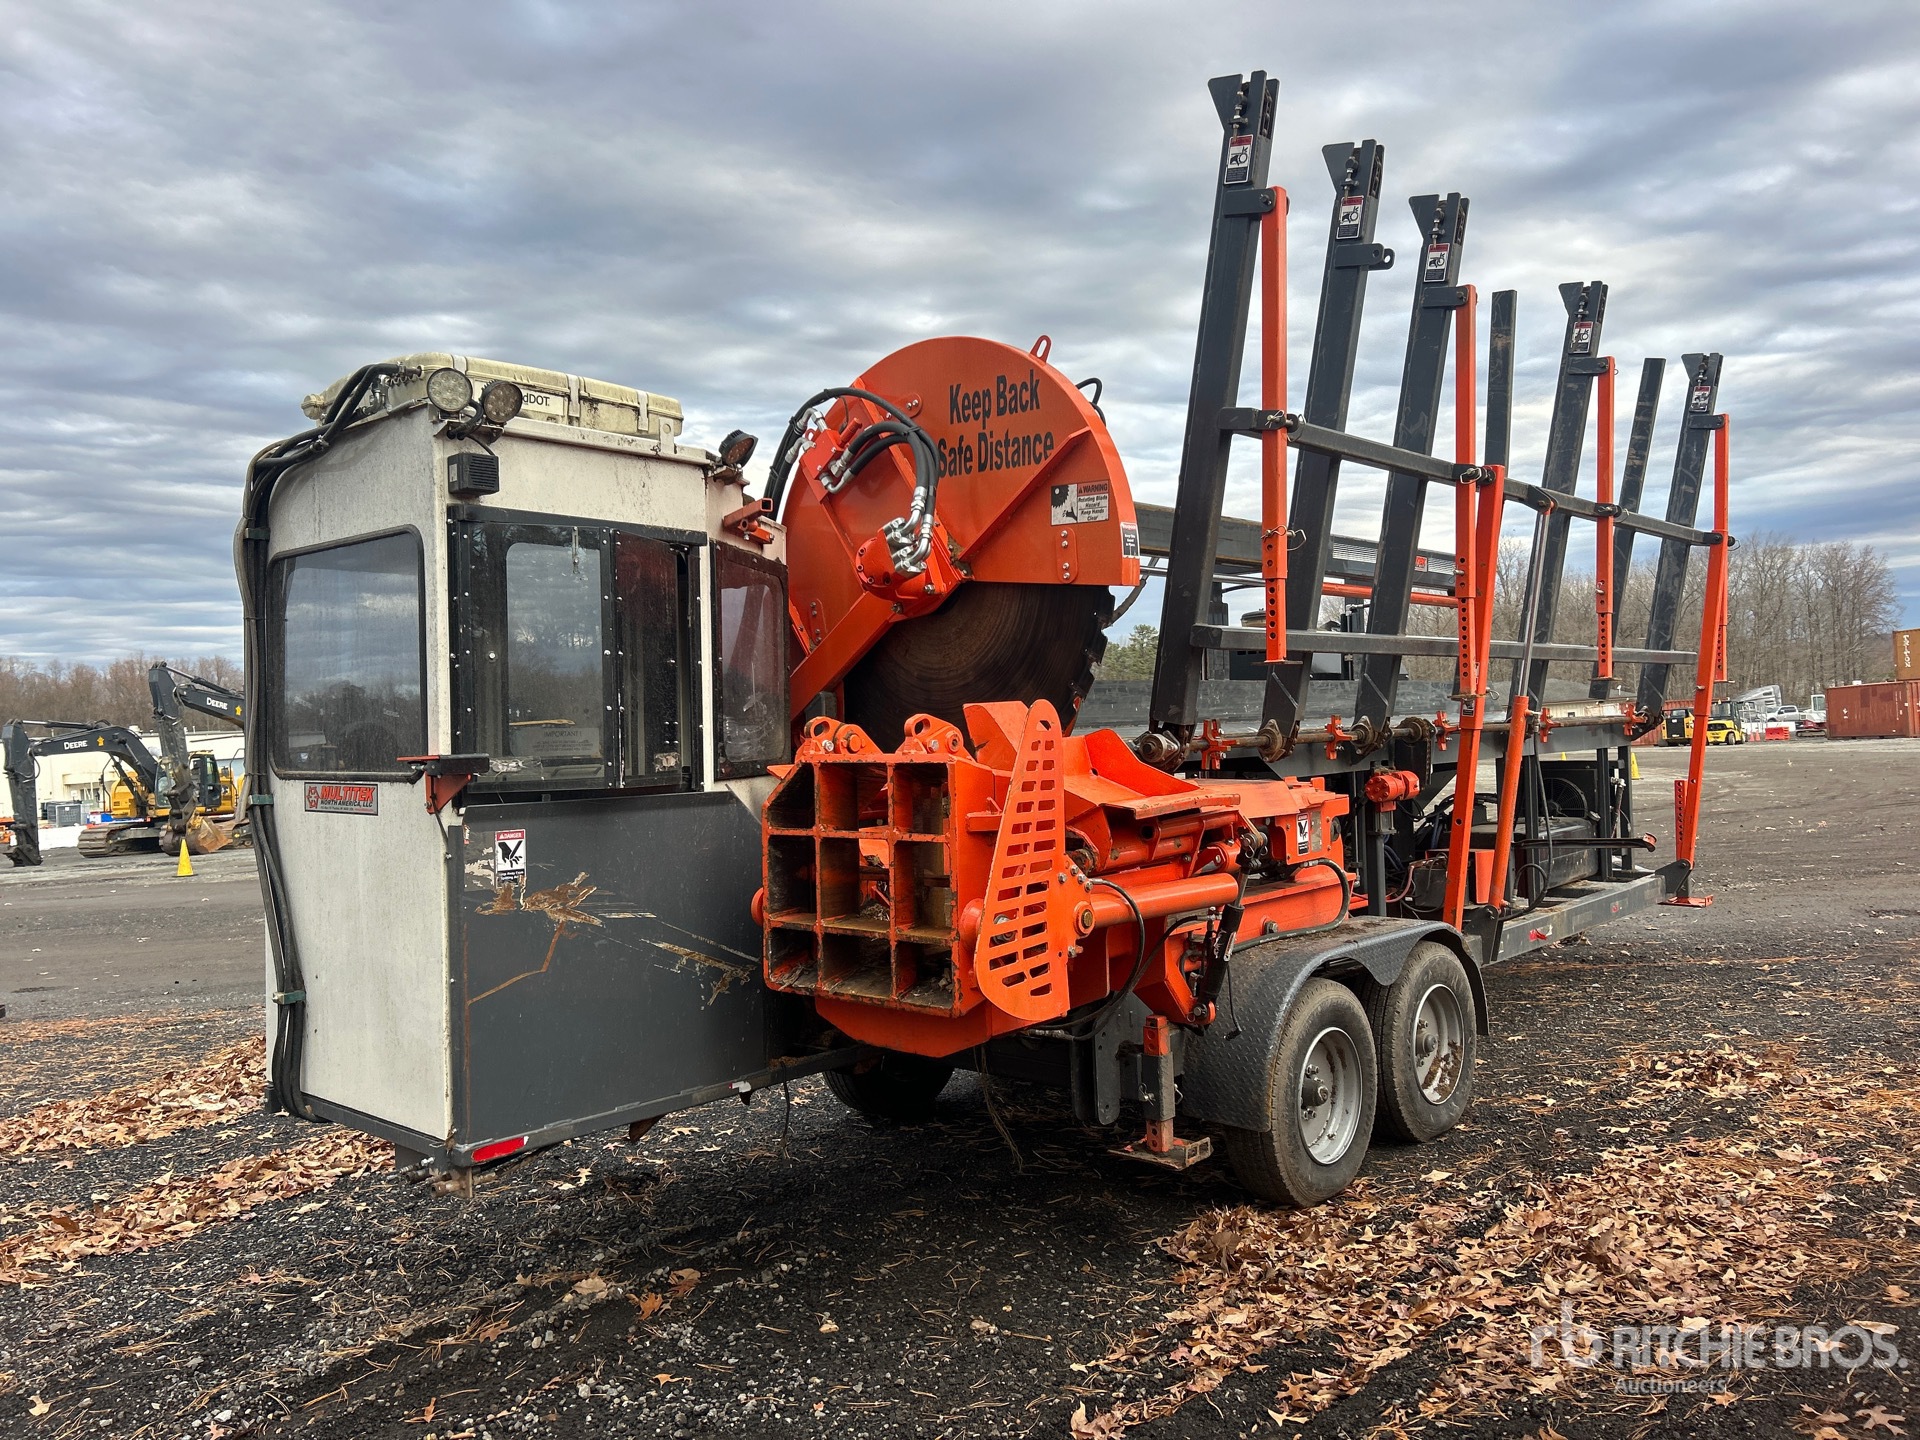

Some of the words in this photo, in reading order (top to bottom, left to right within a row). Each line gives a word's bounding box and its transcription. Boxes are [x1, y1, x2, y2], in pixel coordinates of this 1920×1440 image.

[949, 383, 992, 430] Keep
[996, 369, 1040, 417] Back
[938, 435, 973, 478] Safe
[978, 429, 1054, 473] Distance
[1083, 484, 1107, 493] WARNING
[206, 697, 228, 710] DEERE
[64, 740, 88, 750] DEERE
[319, 785, 375, 801] MULTITEK
